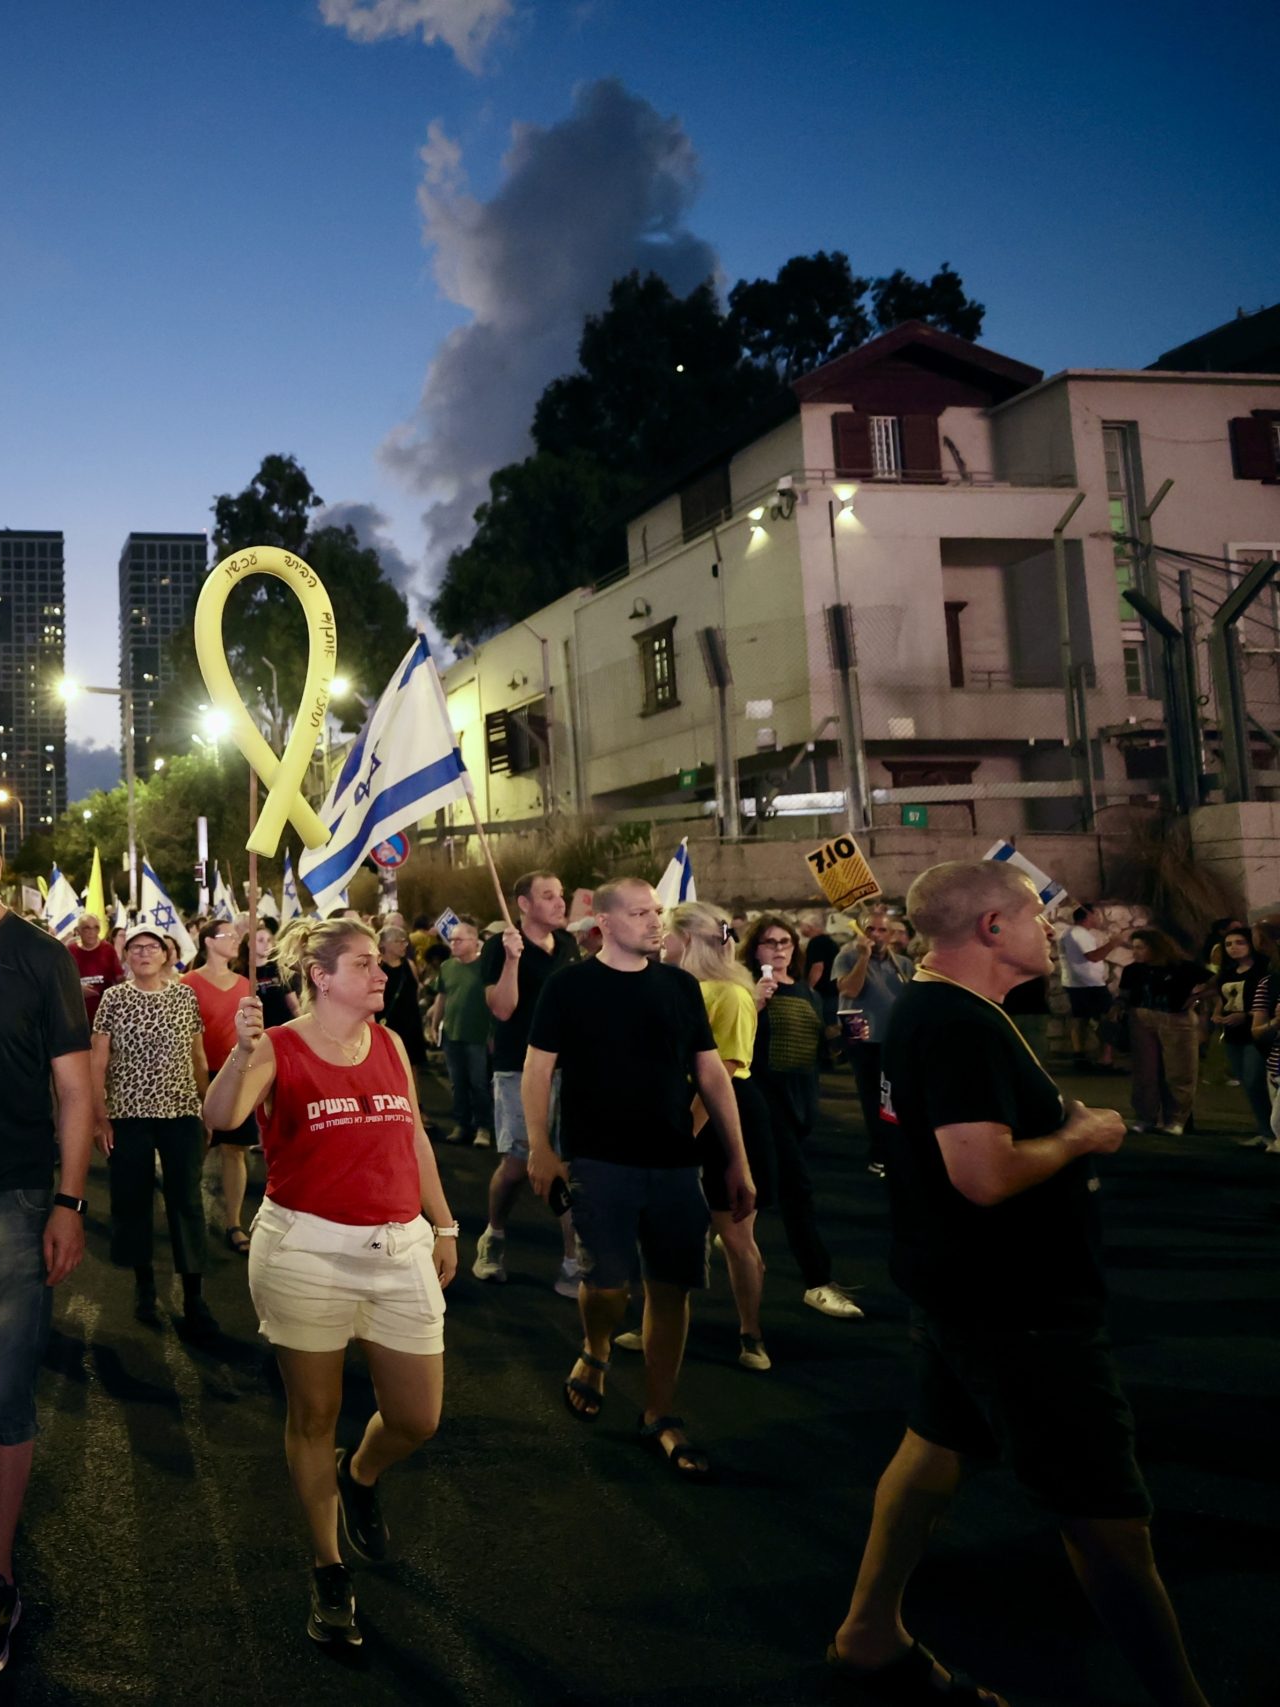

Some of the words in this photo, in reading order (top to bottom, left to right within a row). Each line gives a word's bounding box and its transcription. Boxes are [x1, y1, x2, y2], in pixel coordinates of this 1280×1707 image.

[284, 555, 317, 588] הביתה
[808, 838, 855, 873] 7.10
[307, 1097, 360, 1119] הנשים
